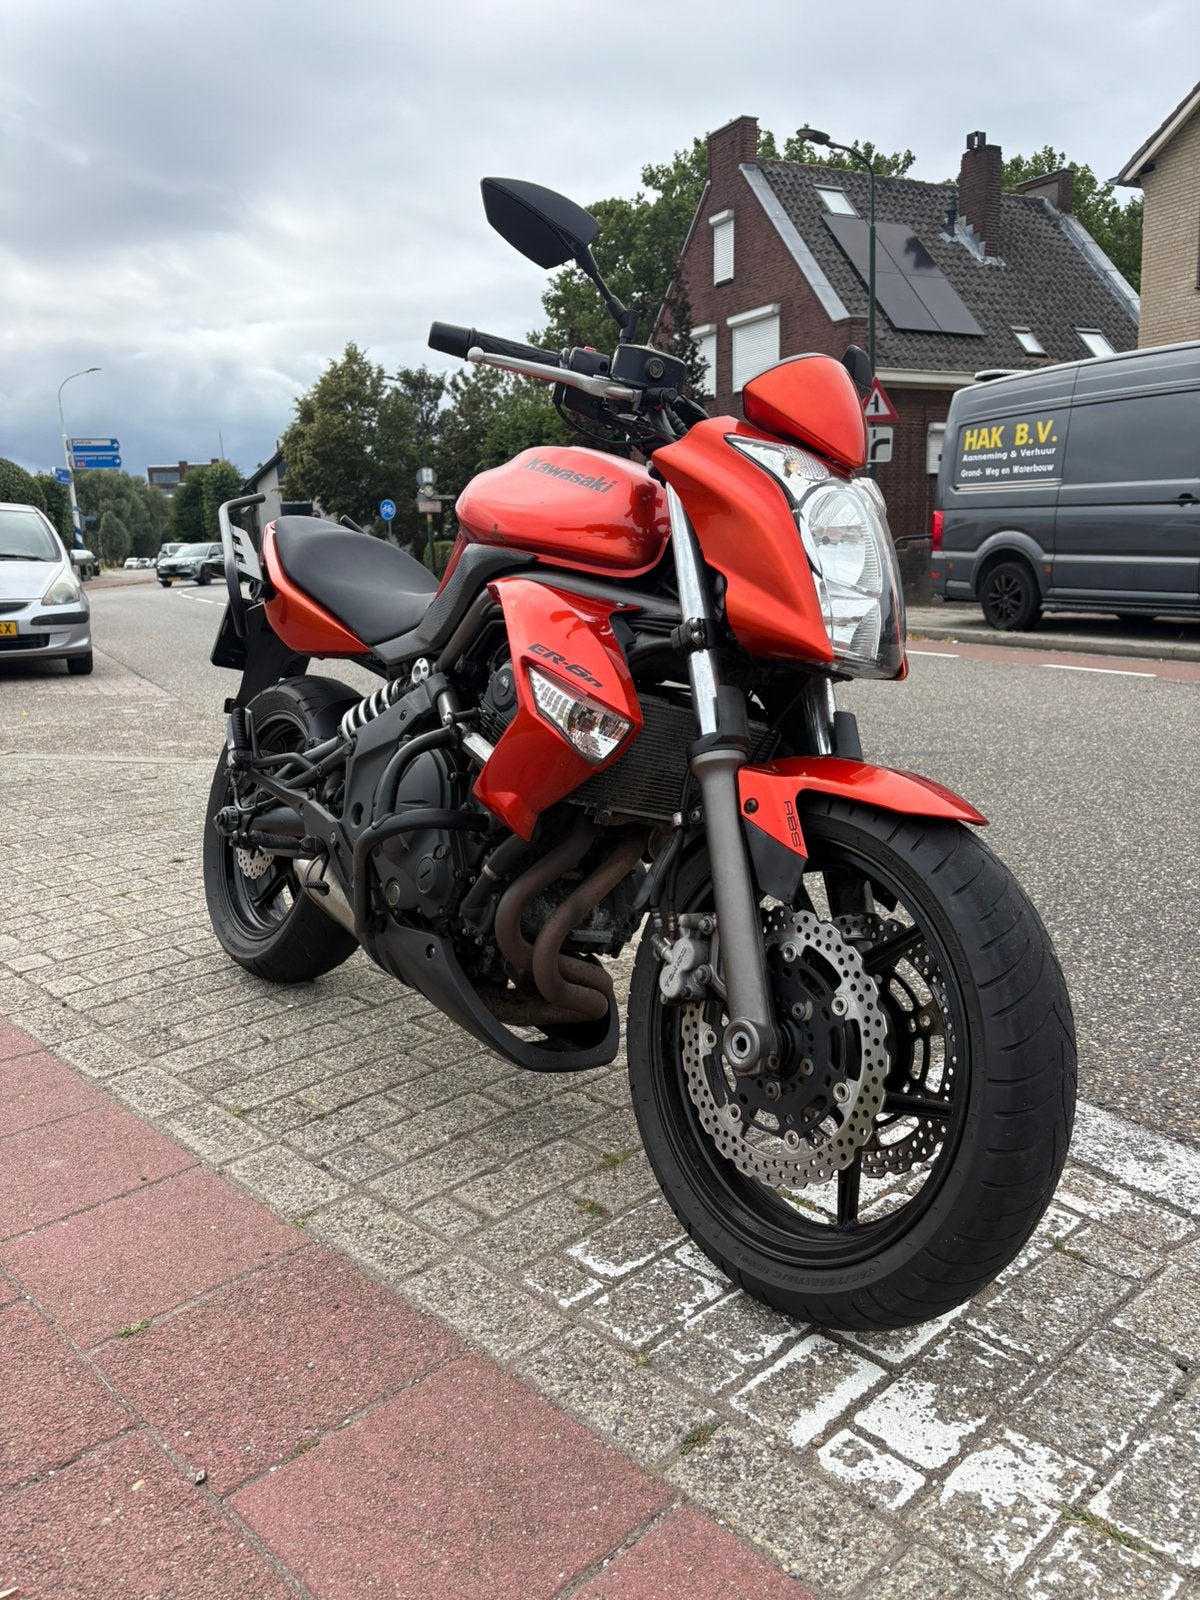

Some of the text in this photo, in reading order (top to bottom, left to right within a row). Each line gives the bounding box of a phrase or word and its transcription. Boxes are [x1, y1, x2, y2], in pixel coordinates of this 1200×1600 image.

[964, 420, 1058, 451] HAK B.V.
[962, 448, 1056, 462] Aanneming & Verhuur
[985, 467, 1000, 476] Weg
[1001, 467, 1010, 475] en
[1012, 464, 1054, 474] Waterbouw
[525, 457, 617, 494] Kawasaki
[528, 643, 603, 689] ER-6n
[783, 800, 802, 848] ABS
